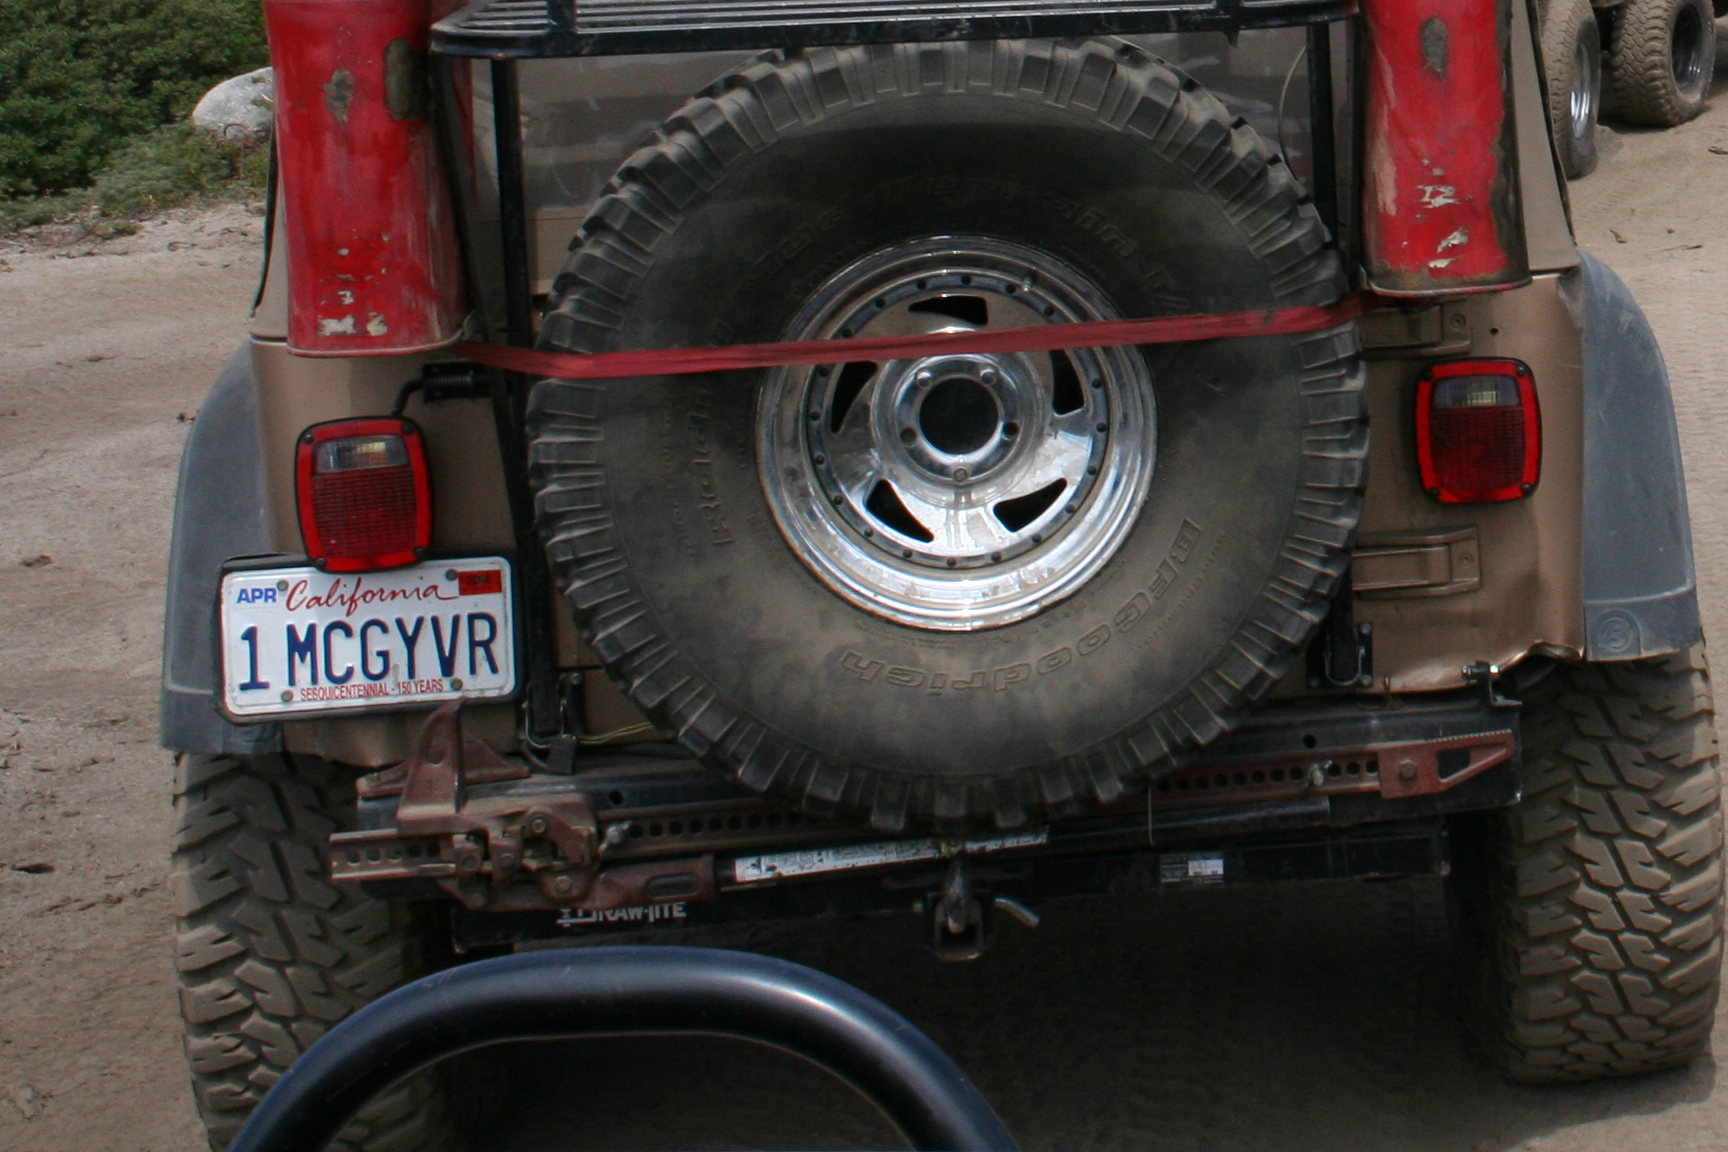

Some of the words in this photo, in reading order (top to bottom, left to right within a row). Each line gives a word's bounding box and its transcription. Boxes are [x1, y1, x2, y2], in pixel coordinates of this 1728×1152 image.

[236, 587, 277, 604] APR
[286, 576, 459, 617] California
[239, 626, 271, 691] 1
[286, 613, 499, 687] MCGYVR
[300, 682, 390, 701] SESQUICENTENNIAL
[413, 679, 444, 694] YEARS
